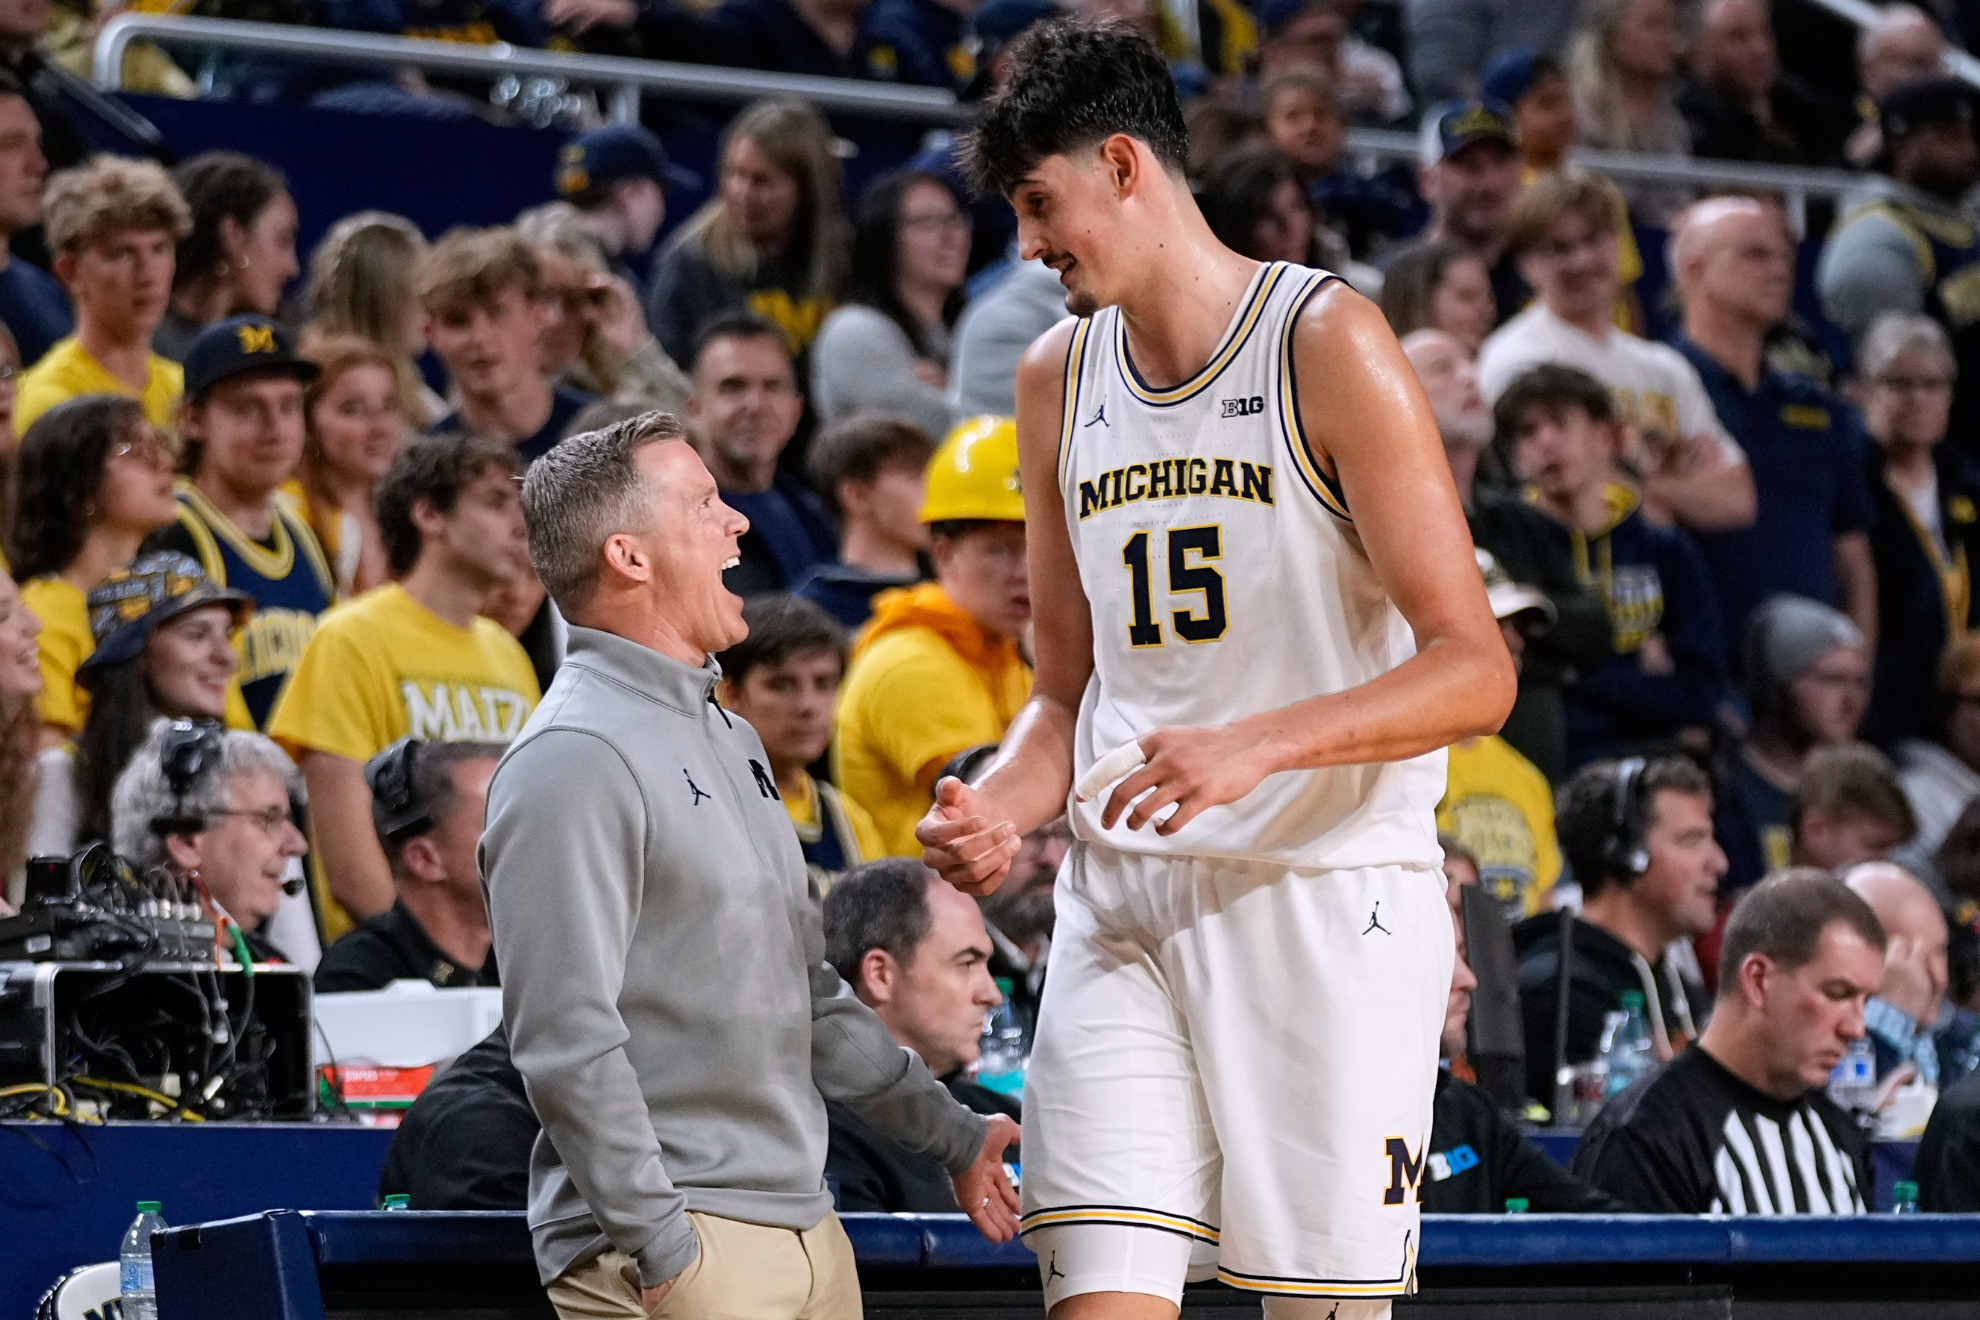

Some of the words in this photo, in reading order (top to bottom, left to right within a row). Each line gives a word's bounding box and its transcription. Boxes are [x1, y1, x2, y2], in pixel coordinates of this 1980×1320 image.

[236, 325, 278, 353] M
[1079, 457, 1275, 522] MICHIGAN
[1122, 523, 1231, 649] 15
[747, 759, 781, 801] M
[1382, 1135, 1423, 1206] M
